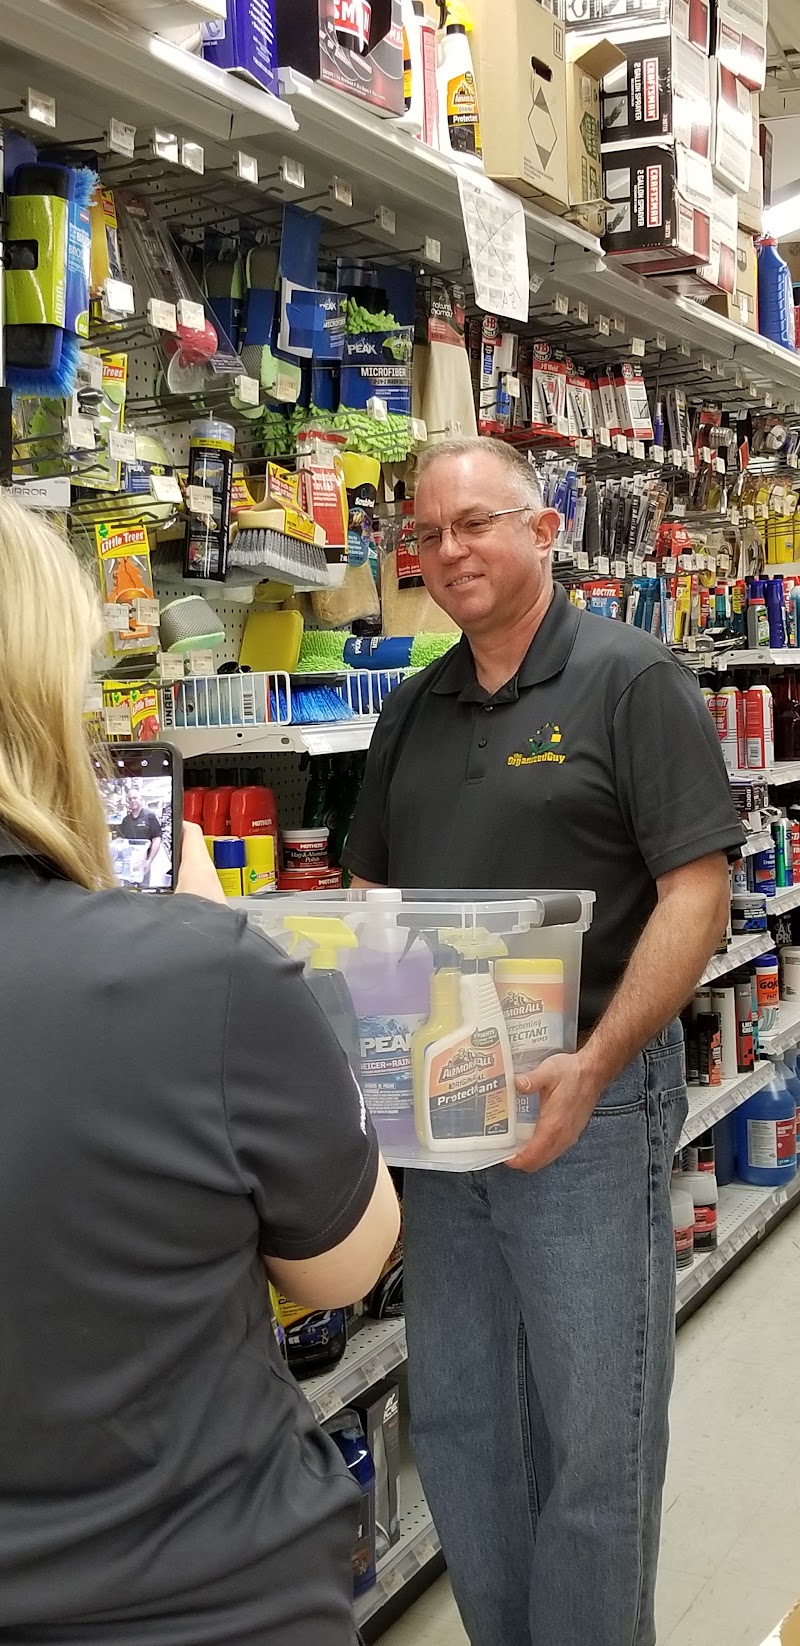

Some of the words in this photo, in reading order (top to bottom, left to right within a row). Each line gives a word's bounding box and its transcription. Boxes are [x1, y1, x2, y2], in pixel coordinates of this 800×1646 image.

[646, 61, 656, 118] CRAFTSMAN
[649, 168, 659, 222] CRAFTSMAN
[347, 343, 377, 355] PEAK
[103, 367, 123, 377] Trees
[361, 367, 407, 377] MICROFIBER
[101, 537, 123, 553] Little
[123, 531, 144, 542] Trees
[592, 588, 617, 597] LOCTITE
[504, 1002, 542, 1018] MORALL
[508, 1026, 548, 1043] TECTANT
[361, 1060, 387, 1070] EICER
